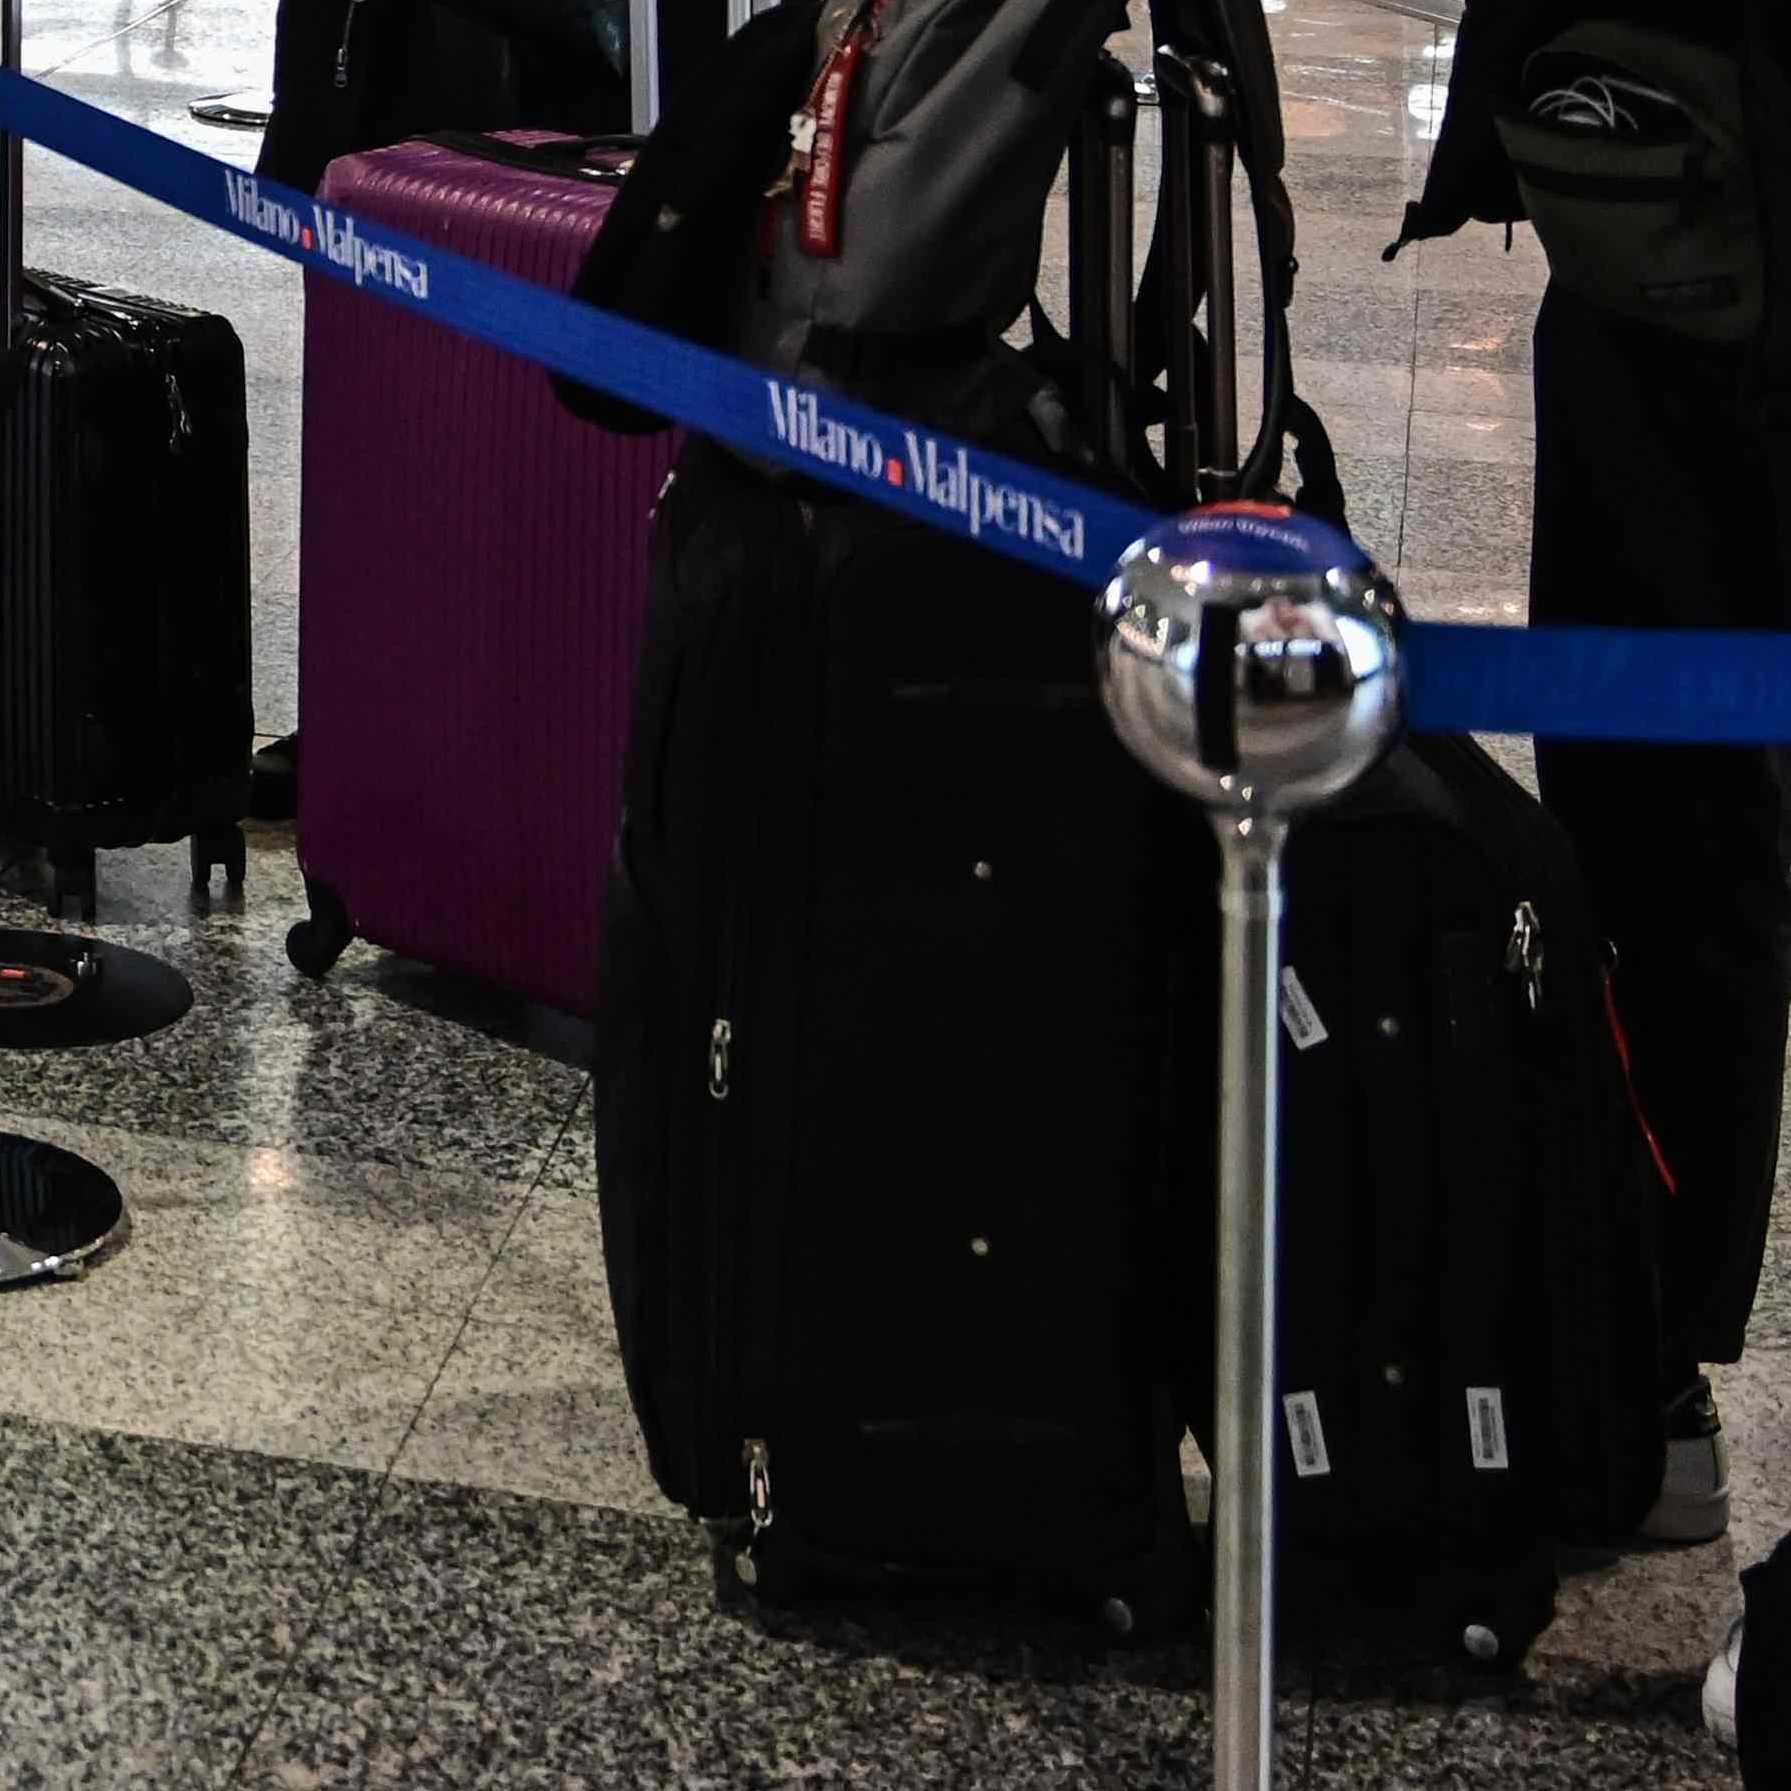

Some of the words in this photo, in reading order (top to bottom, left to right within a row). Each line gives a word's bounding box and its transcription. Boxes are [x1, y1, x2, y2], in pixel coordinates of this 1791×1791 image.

[224, 167, 299, 245] Milano
[311, 202, 429, 299] Malpensa
[767, 378, 883, 479] Milano
[903, 429, 1085, 560] Malpensa
